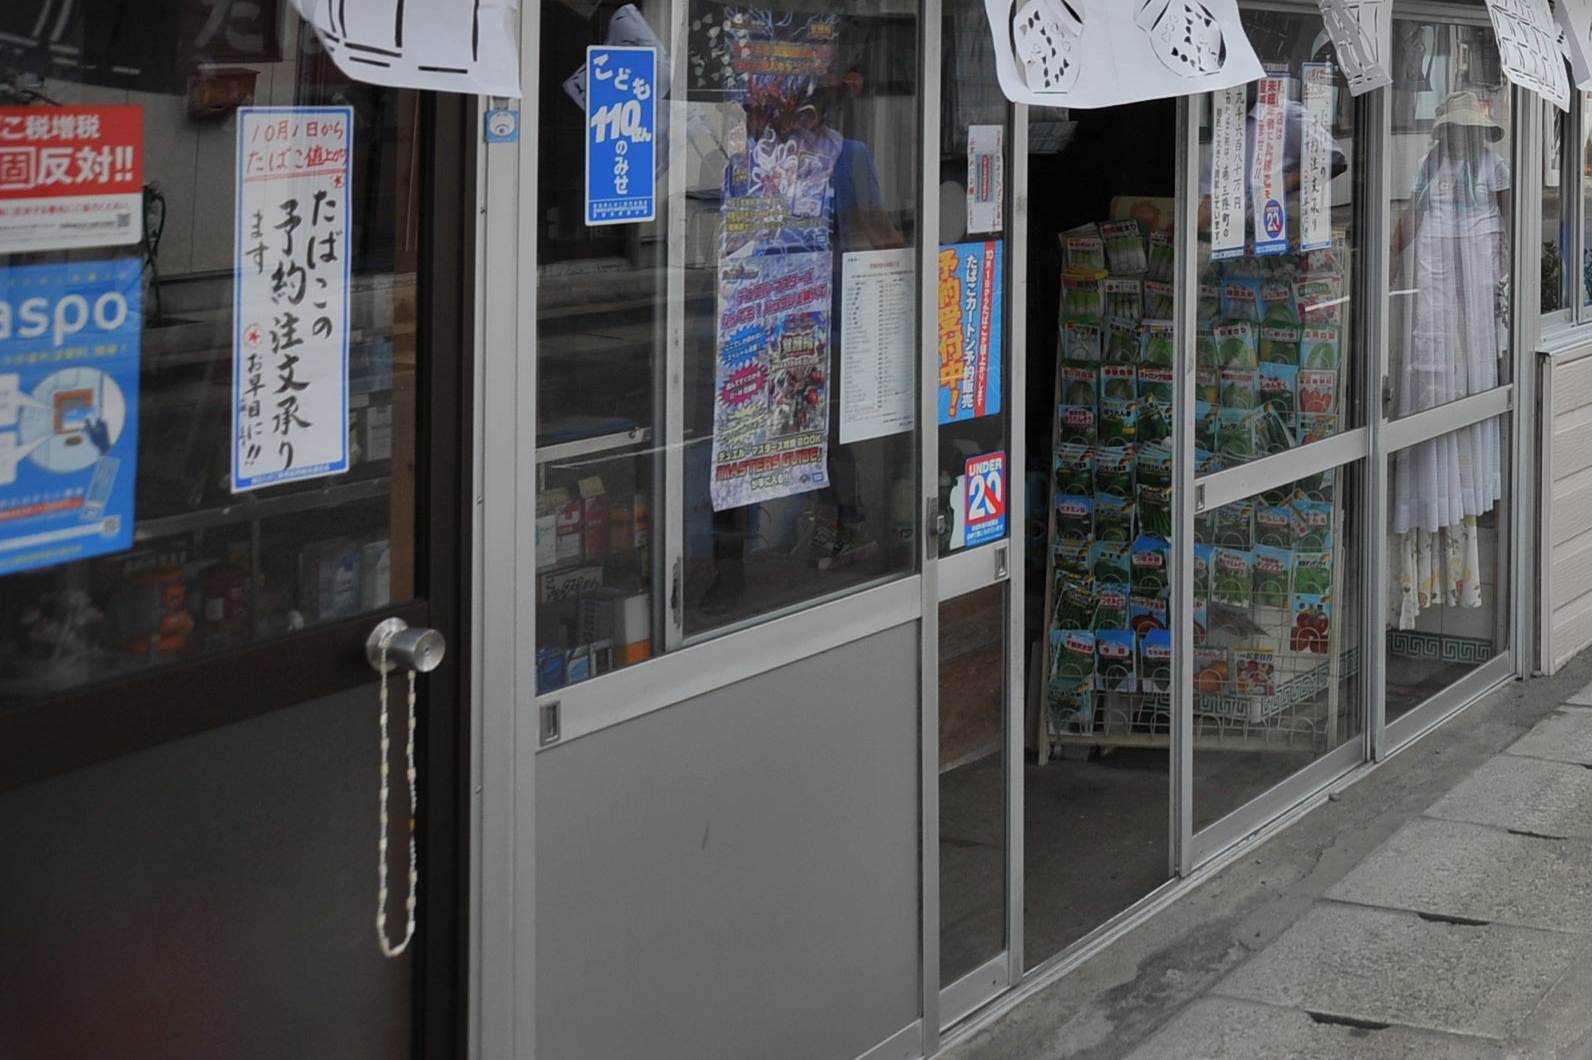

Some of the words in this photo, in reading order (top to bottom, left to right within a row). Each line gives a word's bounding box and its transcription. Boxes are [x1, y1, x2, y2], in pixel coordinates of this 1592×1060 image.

[593, 54, 651, 101] こども
[0, 114, 101, 140] こ税増税
[252, 120, 343, 142] 10月1日から
[614, 141, 630, 195] のみせ
[246, 210, 269, 273] ます
[306, 190, 342, 338] たばこの
[270, 199, 312, 471] 予約注文承り
[962, 254, 977, 408] たばこカートン予約販売
[969, 458, 1002, 476] UNDER
[969, 471, 1002, 521] 20
